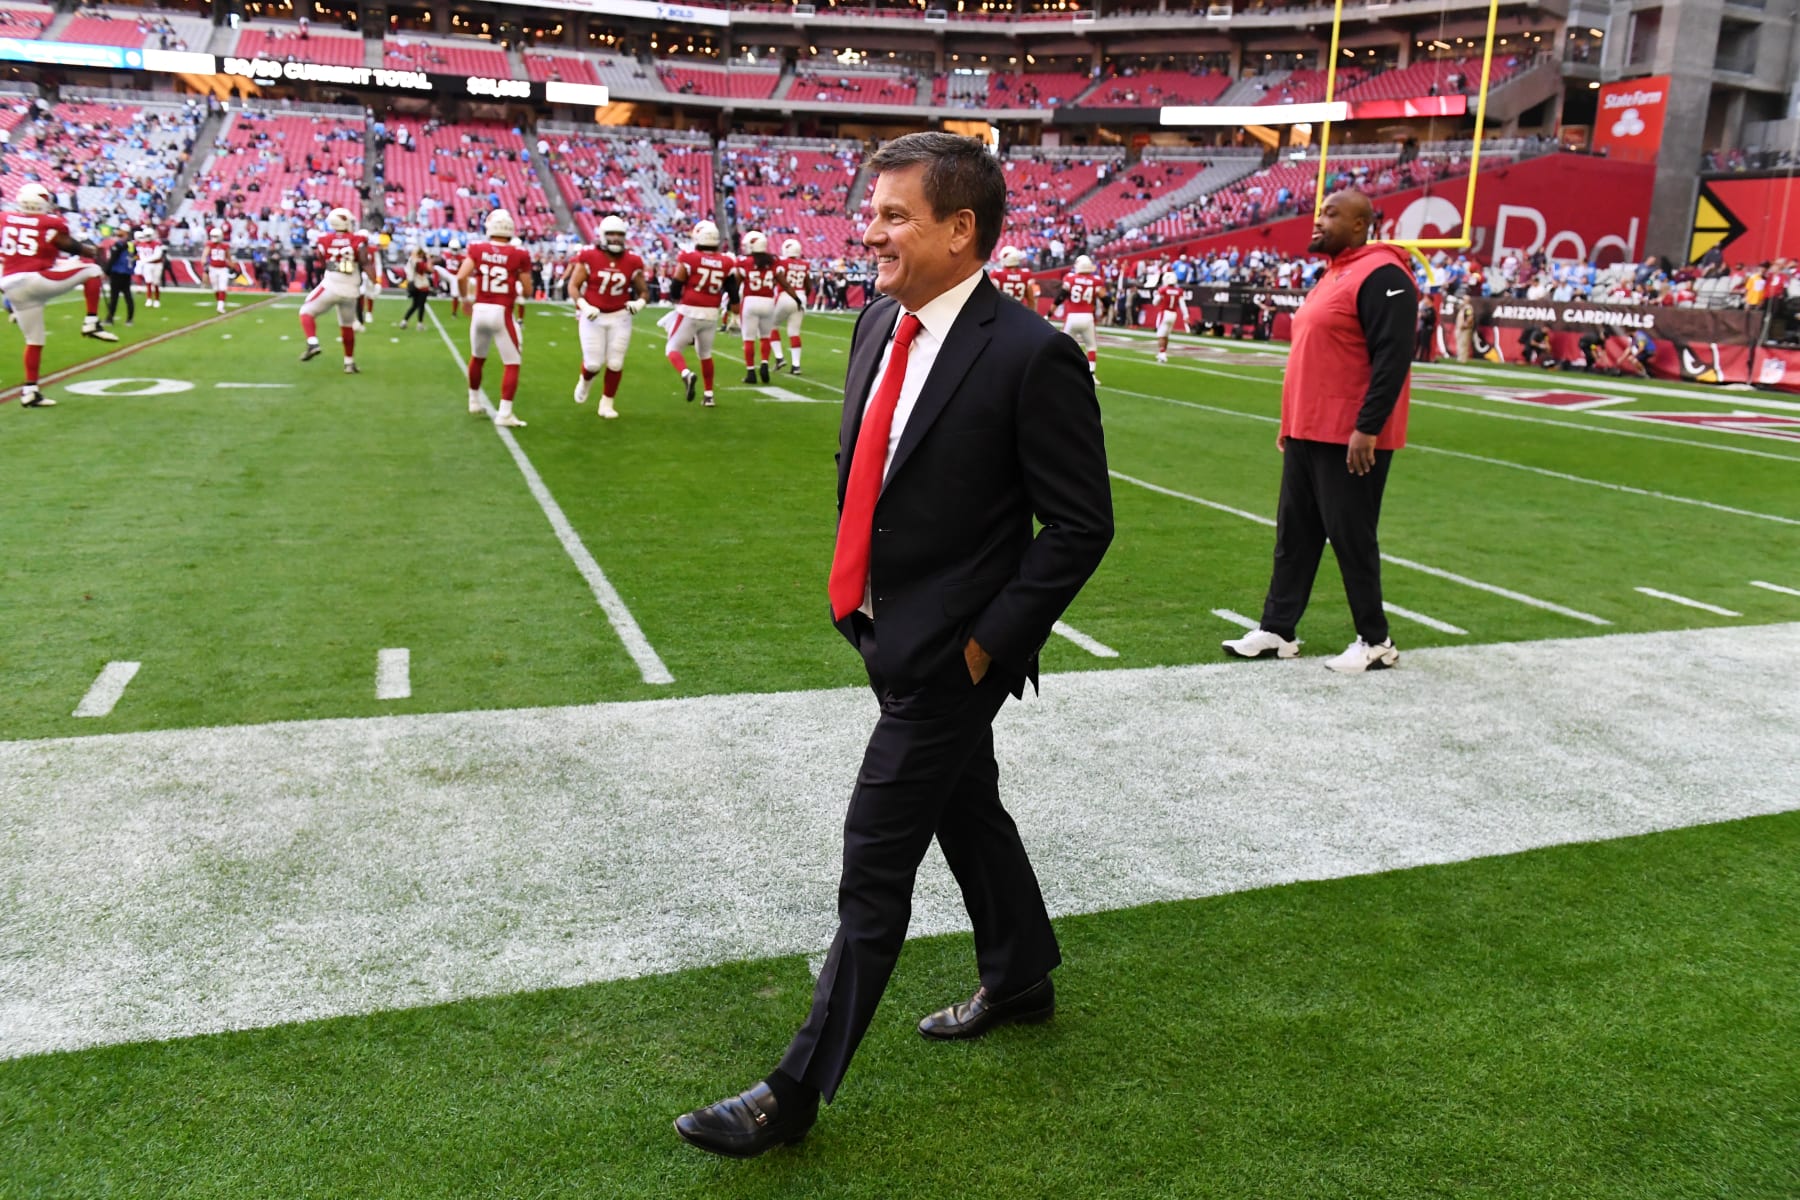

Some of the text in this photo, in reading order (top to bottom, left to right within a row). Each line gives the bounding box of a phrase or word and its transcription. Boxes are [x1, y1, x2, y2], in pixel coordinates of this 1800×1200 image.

[284, 62, 372, 86] CURRENT
[373, 69, 433, 90] TOTAL
[2, 226, 39, 256] 65
[1491, 204, 1640, 272] Red
[480, 264, 509, 294] 12
[597, 270, 626, 296] 72
[694, 267, 724, 294] 75
[748, 270, 774, 291] 54
[1002, 282, 1026, 301] 53
[1070, 284, 1094, 304] 64
[1169, 294, 1176, 309] 1
[1492, 305, 1655, 328] ARIZONA CARDINALS
